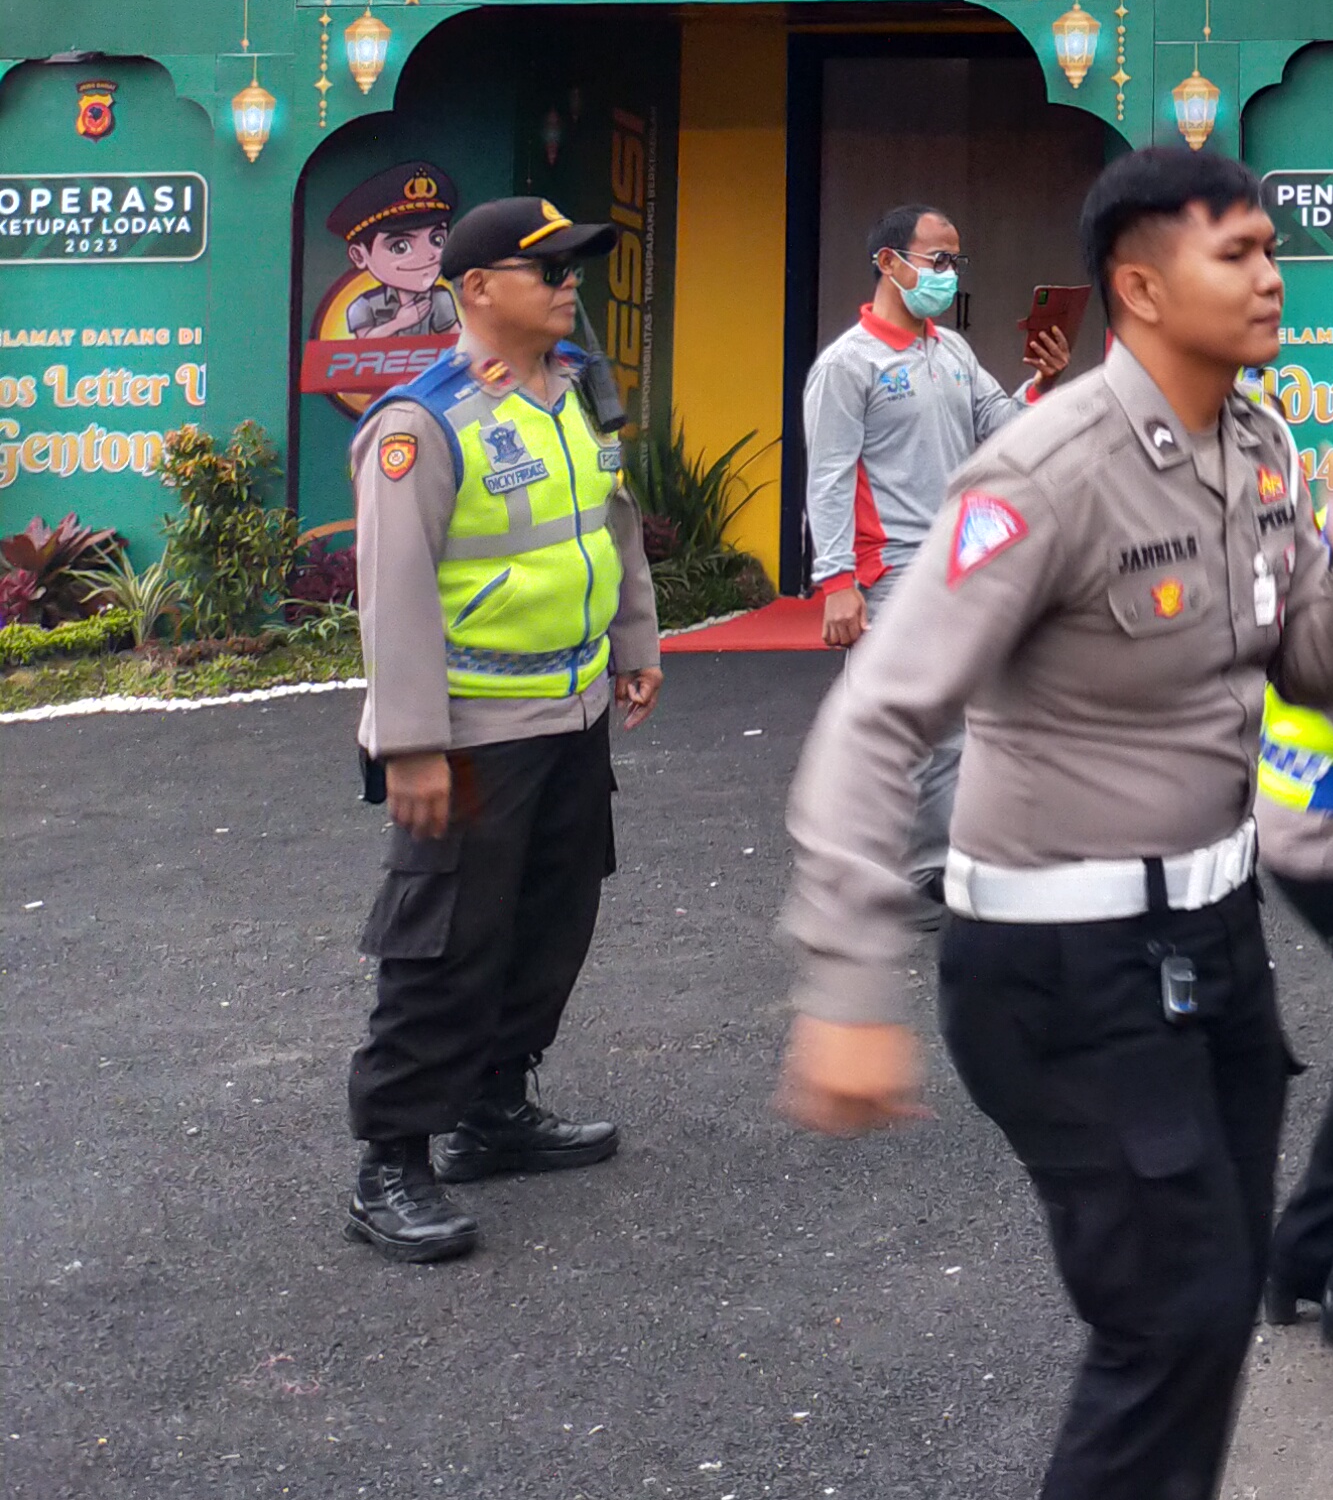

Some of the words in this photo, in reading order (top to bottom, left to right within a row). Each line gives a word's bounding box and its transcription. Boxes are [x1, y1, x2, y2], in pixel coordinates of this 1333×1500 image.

[0, 185, 193, 215] OPERASI
[101, 215, 192, 235] LODAYA
[64, 238, 119, 253] 2023
[81, 327, 170, 347] DATANG
[178, 327, 202, 346] DI
[326, 348, 440, 378] PRES
[43, 364, 171, 409] Letter
